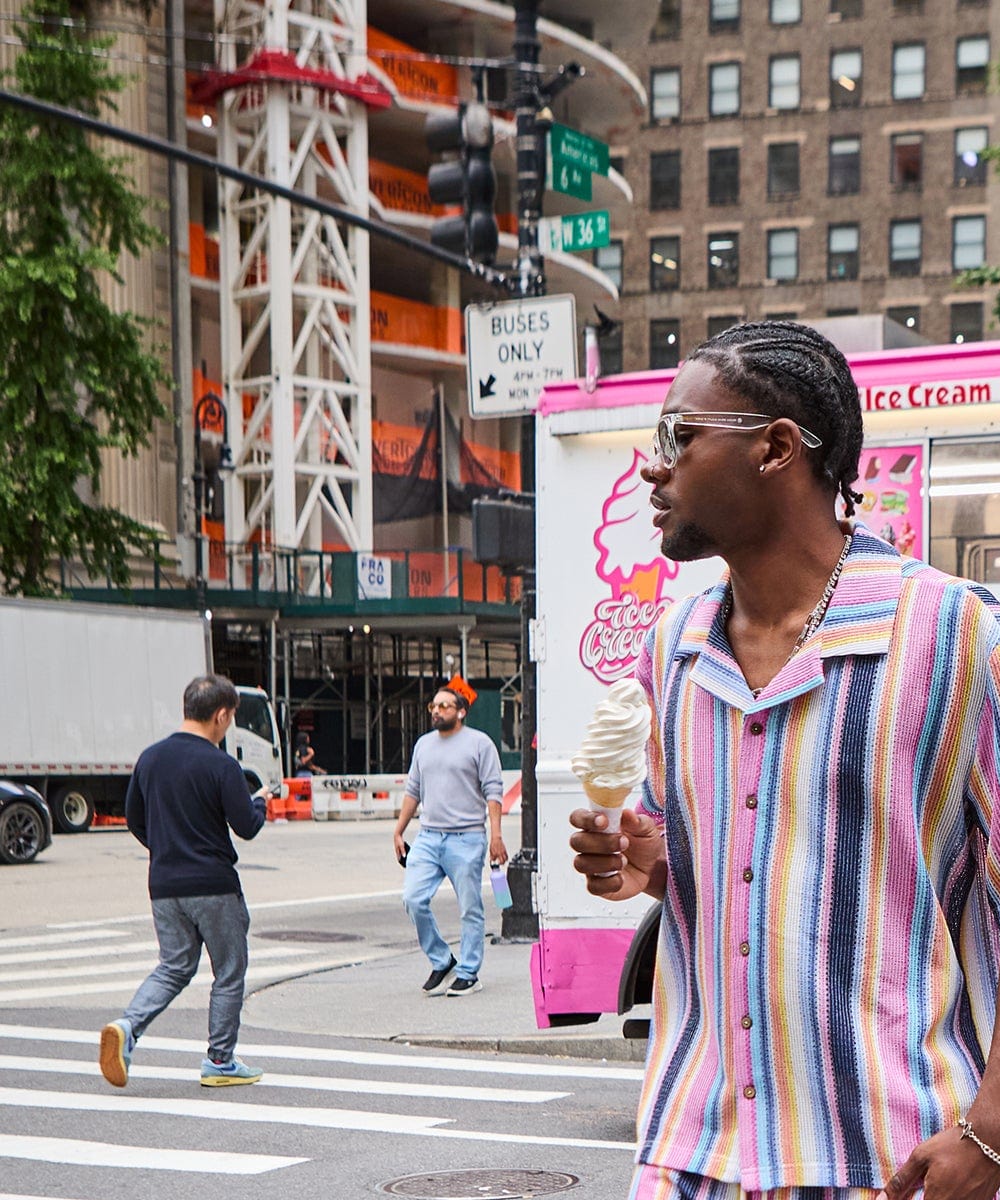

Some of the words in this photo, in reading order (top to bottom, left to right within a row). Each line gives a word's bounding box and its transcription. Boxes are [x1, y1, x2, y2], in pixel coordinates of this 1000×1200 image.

[561, 165, 569, 190] 6
[563, 220, 574, 247] W
[578, 217, 594, 246] 36
[491, 311, 550, 337] BUSES
[498, 340, 544, 363] ONLY
[866, 386, 901, 412] Ice
[908, 383, 992, 408] Cream
[596, 593, 671, 630] Ice
